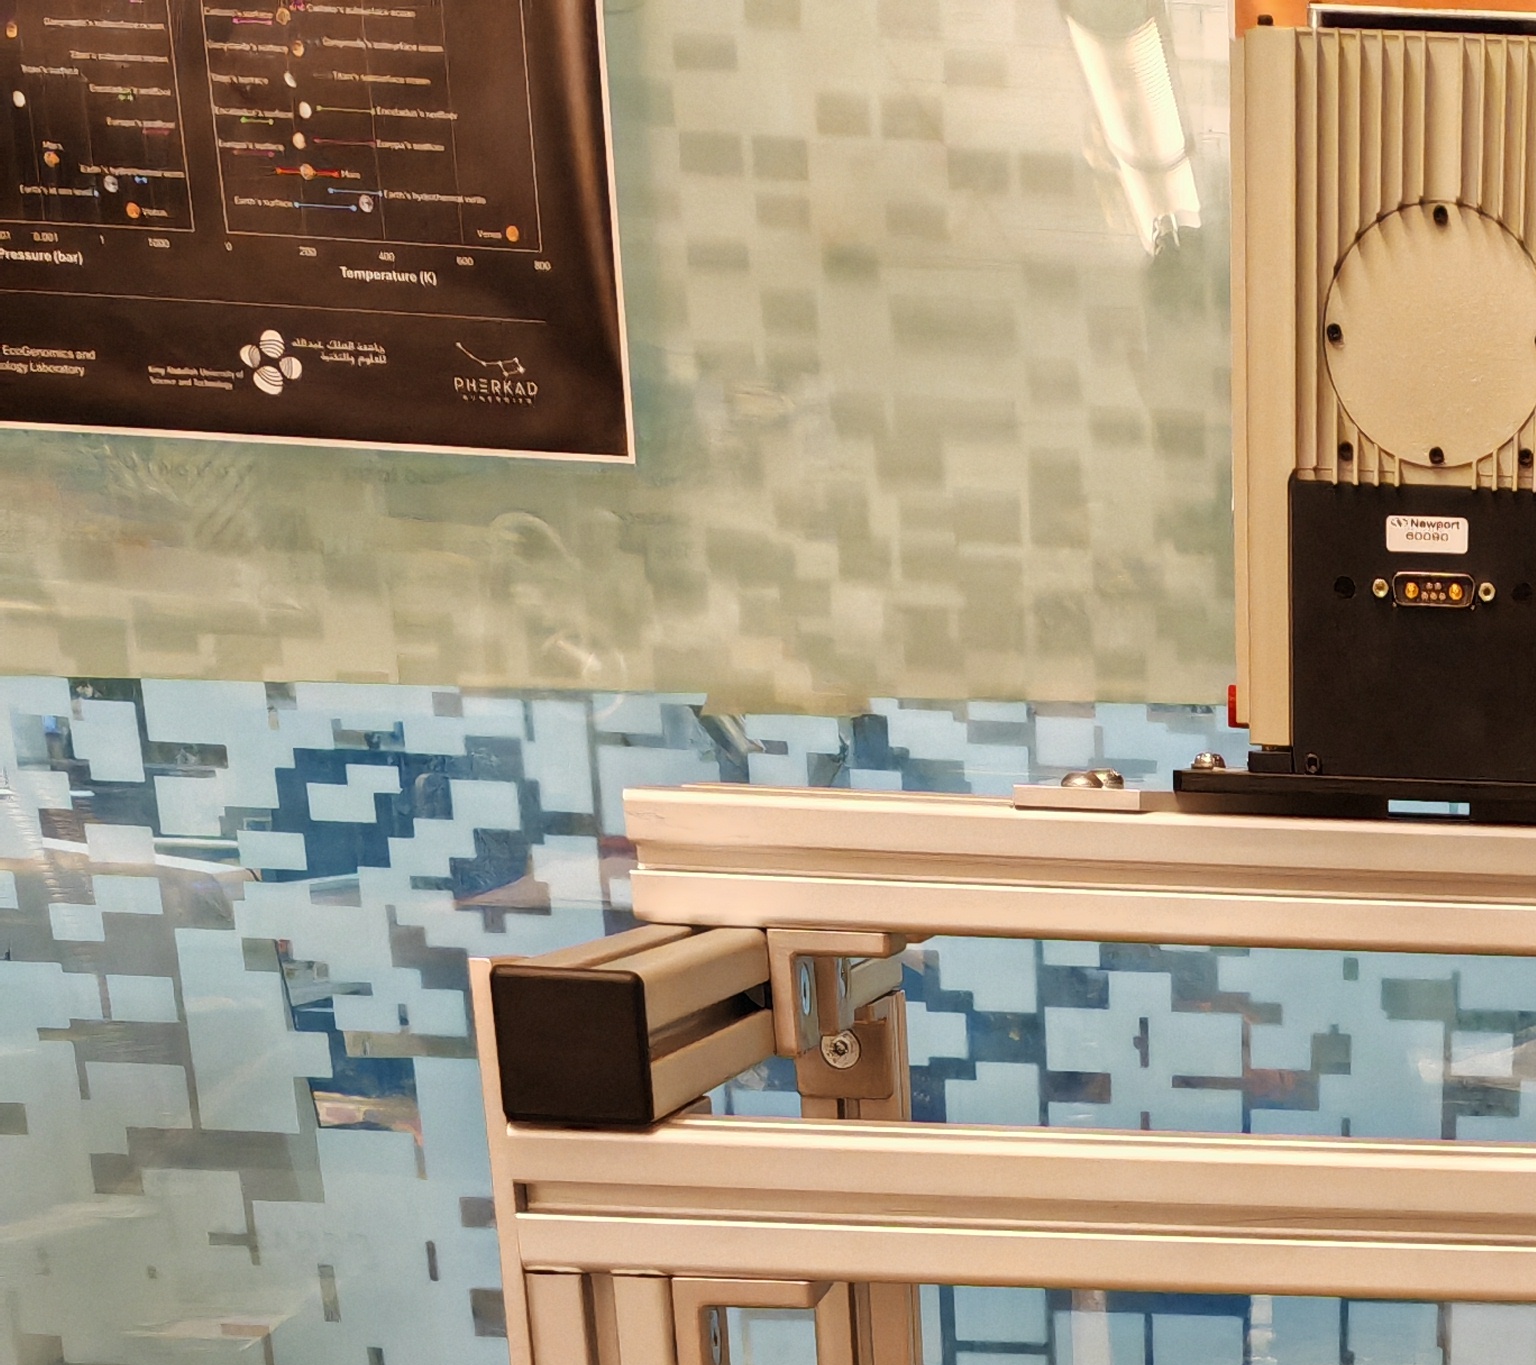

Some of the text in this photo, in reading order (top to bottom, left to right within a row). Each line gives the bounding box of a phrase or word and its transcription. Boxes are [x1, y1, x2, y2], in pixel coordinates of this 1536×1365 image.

[53, 251, 84, 266] (bar)
[339, 266, 438, 286] Temperature (K)
[76, 350, 96, 360] and
[30, 362, 85, 377] Laboratory
[1410, 518, 1460, 531] Newport
